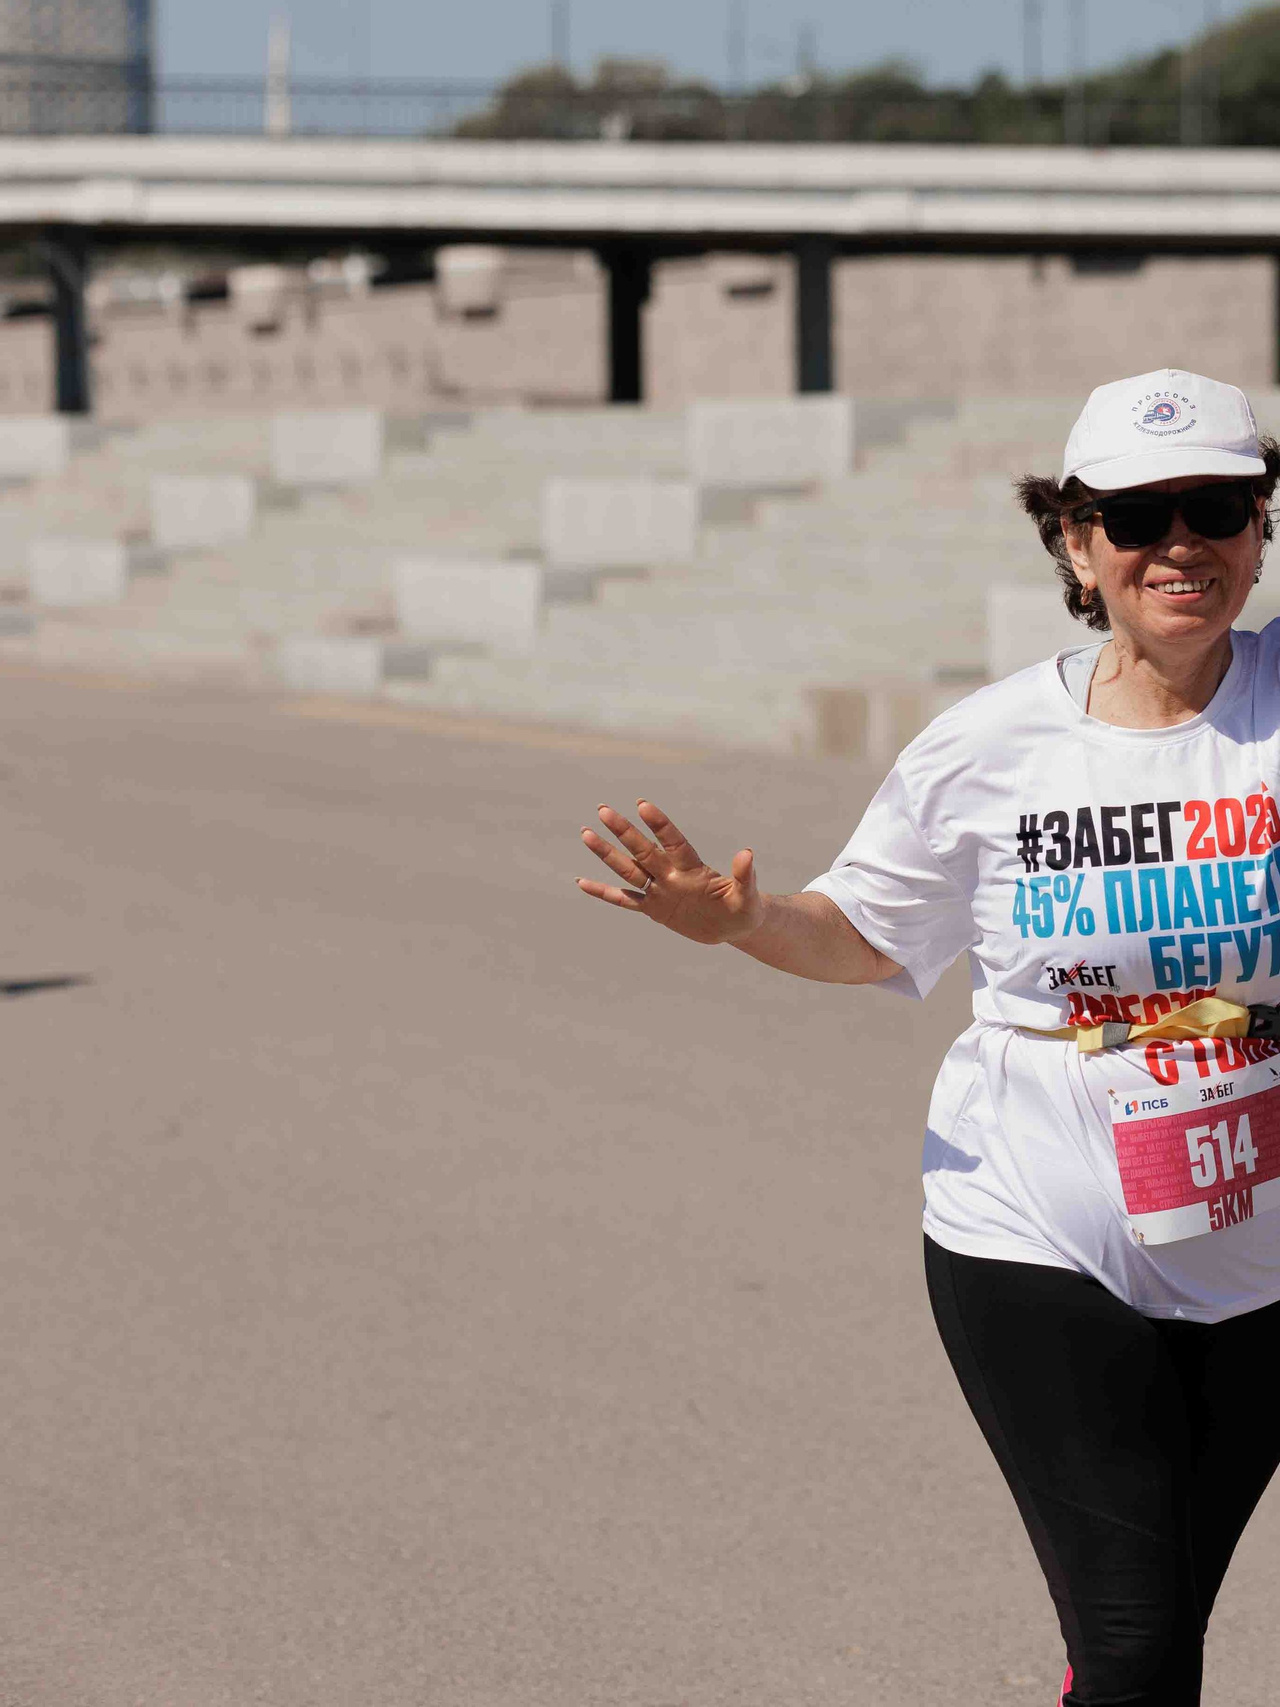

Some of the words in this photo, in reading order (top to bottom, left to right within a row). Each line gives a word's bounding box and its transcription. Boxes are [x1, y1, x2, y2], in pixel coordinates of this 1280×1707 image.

[1131, 391, 1196, 412] ПРОФСОЮЗ
[1133, 419, 1197, 437] ЖЕЛЕЗНОДОРОЖНИКОВ
[1012, 872, 1096, 938] 45%
[1145, 1041, 1179, 1086] С
[1142, 1098, 1169, 1111] ПСБ
[1185, 1113, 1259, 1189] 514
